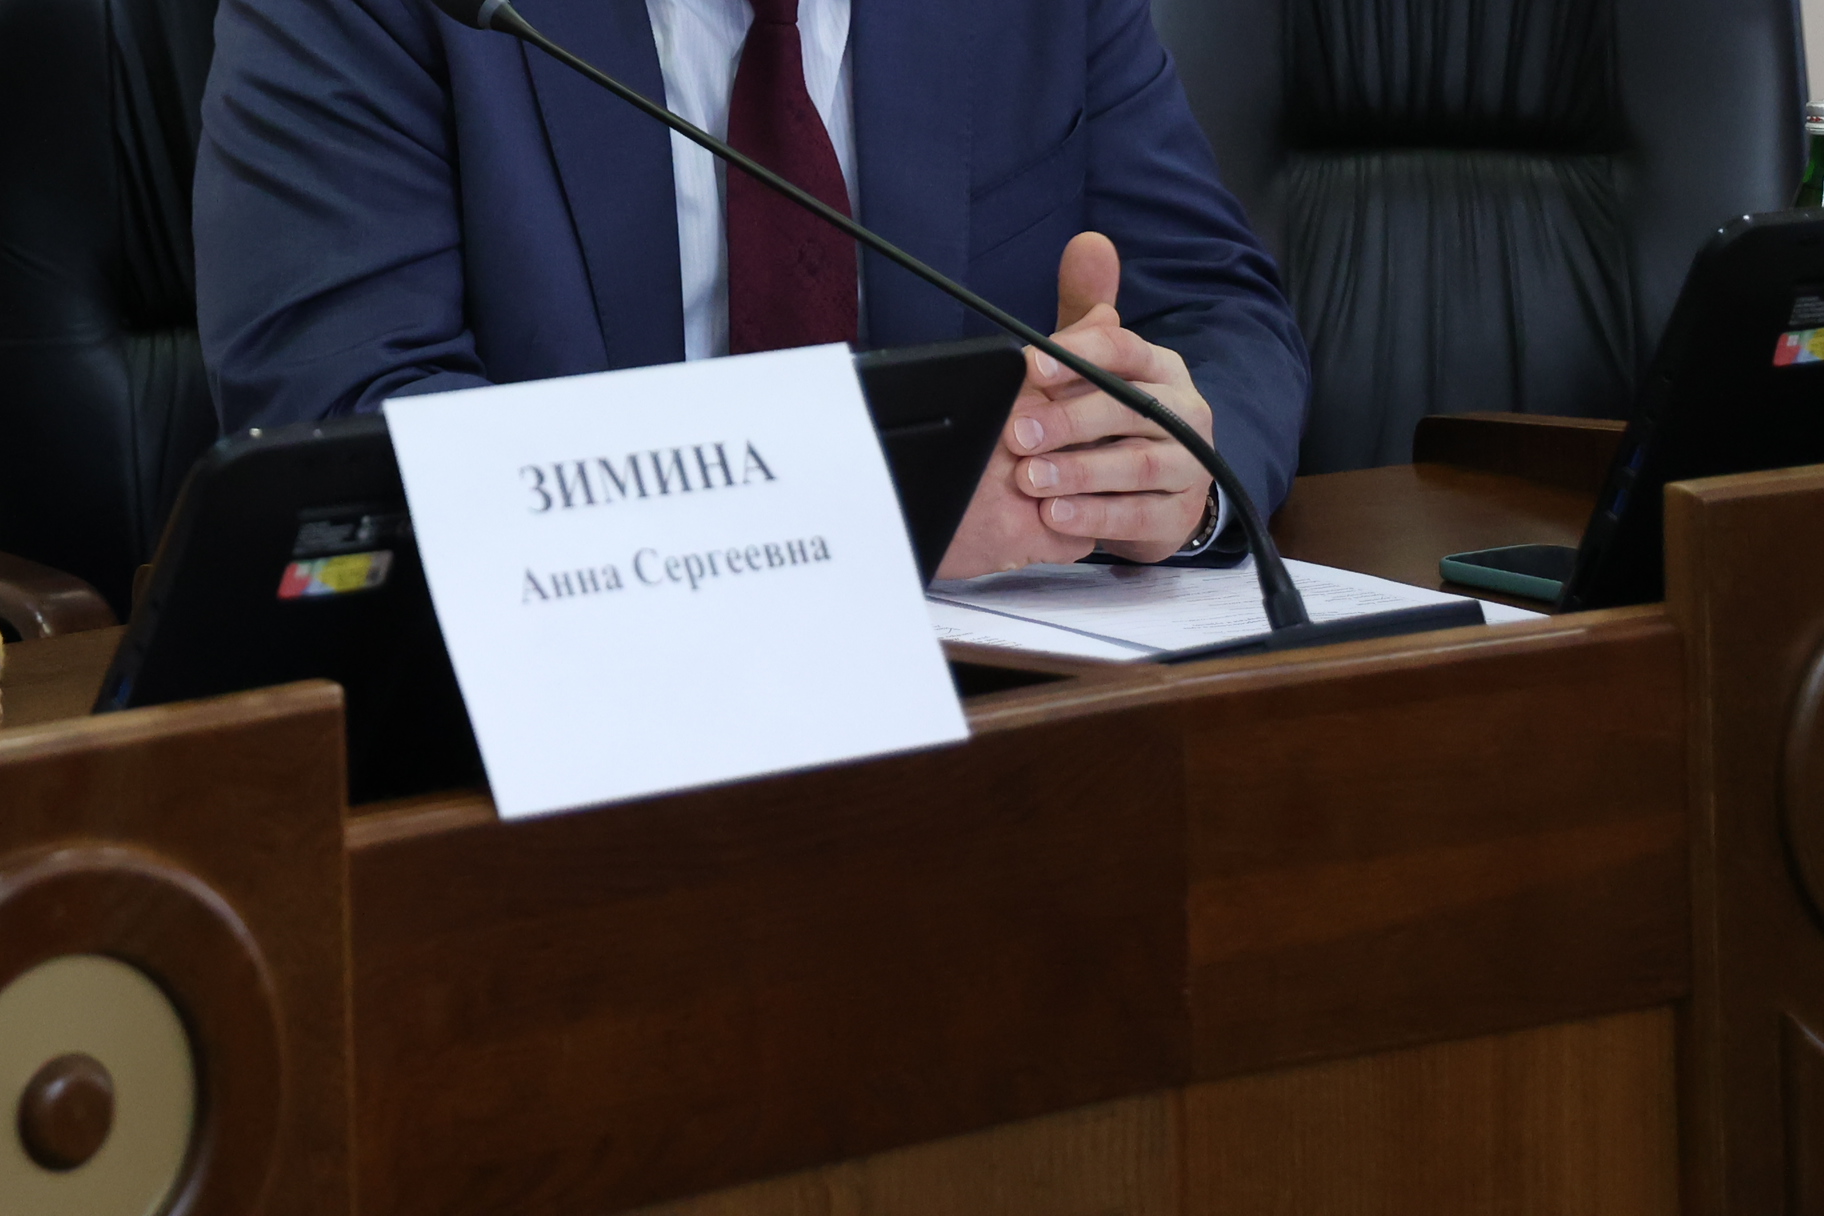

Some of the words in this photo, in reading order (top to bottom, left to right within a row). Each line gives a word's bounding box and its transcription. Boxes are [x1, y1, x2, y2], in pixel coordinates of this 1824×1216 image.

[520, 437, 777, 512] ЗИМИНА
[522, 566, 624, 603] Анна
[632, 534, 832, 592] Сергеевна
